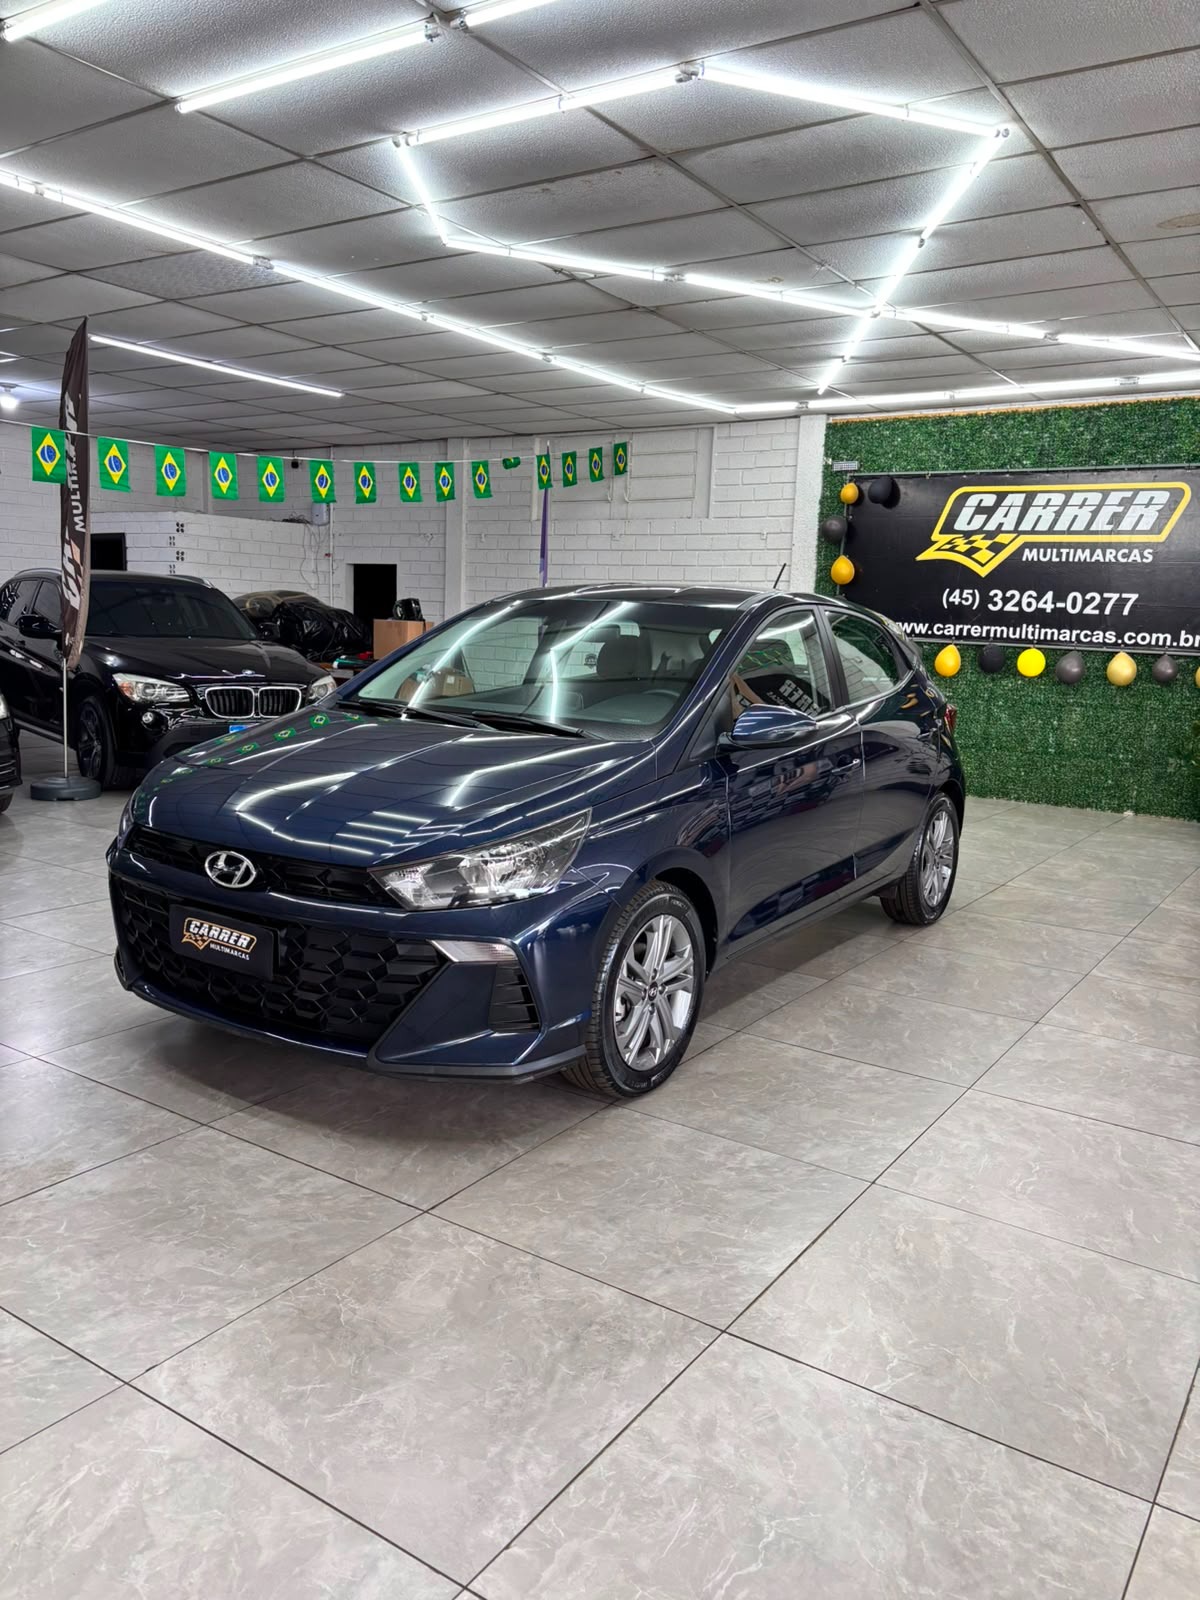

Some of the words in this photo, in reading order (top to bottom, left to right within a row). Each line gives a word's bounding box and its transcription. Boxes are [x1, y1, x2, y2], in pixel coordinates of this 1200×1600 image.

[953, 490, 1171, 532] CARRER
[1022, 548, 1154, 563] MULTIMARCAS
[942, 588, 980, 610] (45)
[987, 589, 1139, 616] 3264-0277
[896, 621, 1200, 648] ww.carrermultimarcas.com.br
[189, 920, 251, 948] CARRER
[209, 943, 250, 960] MULTIMARCAS
